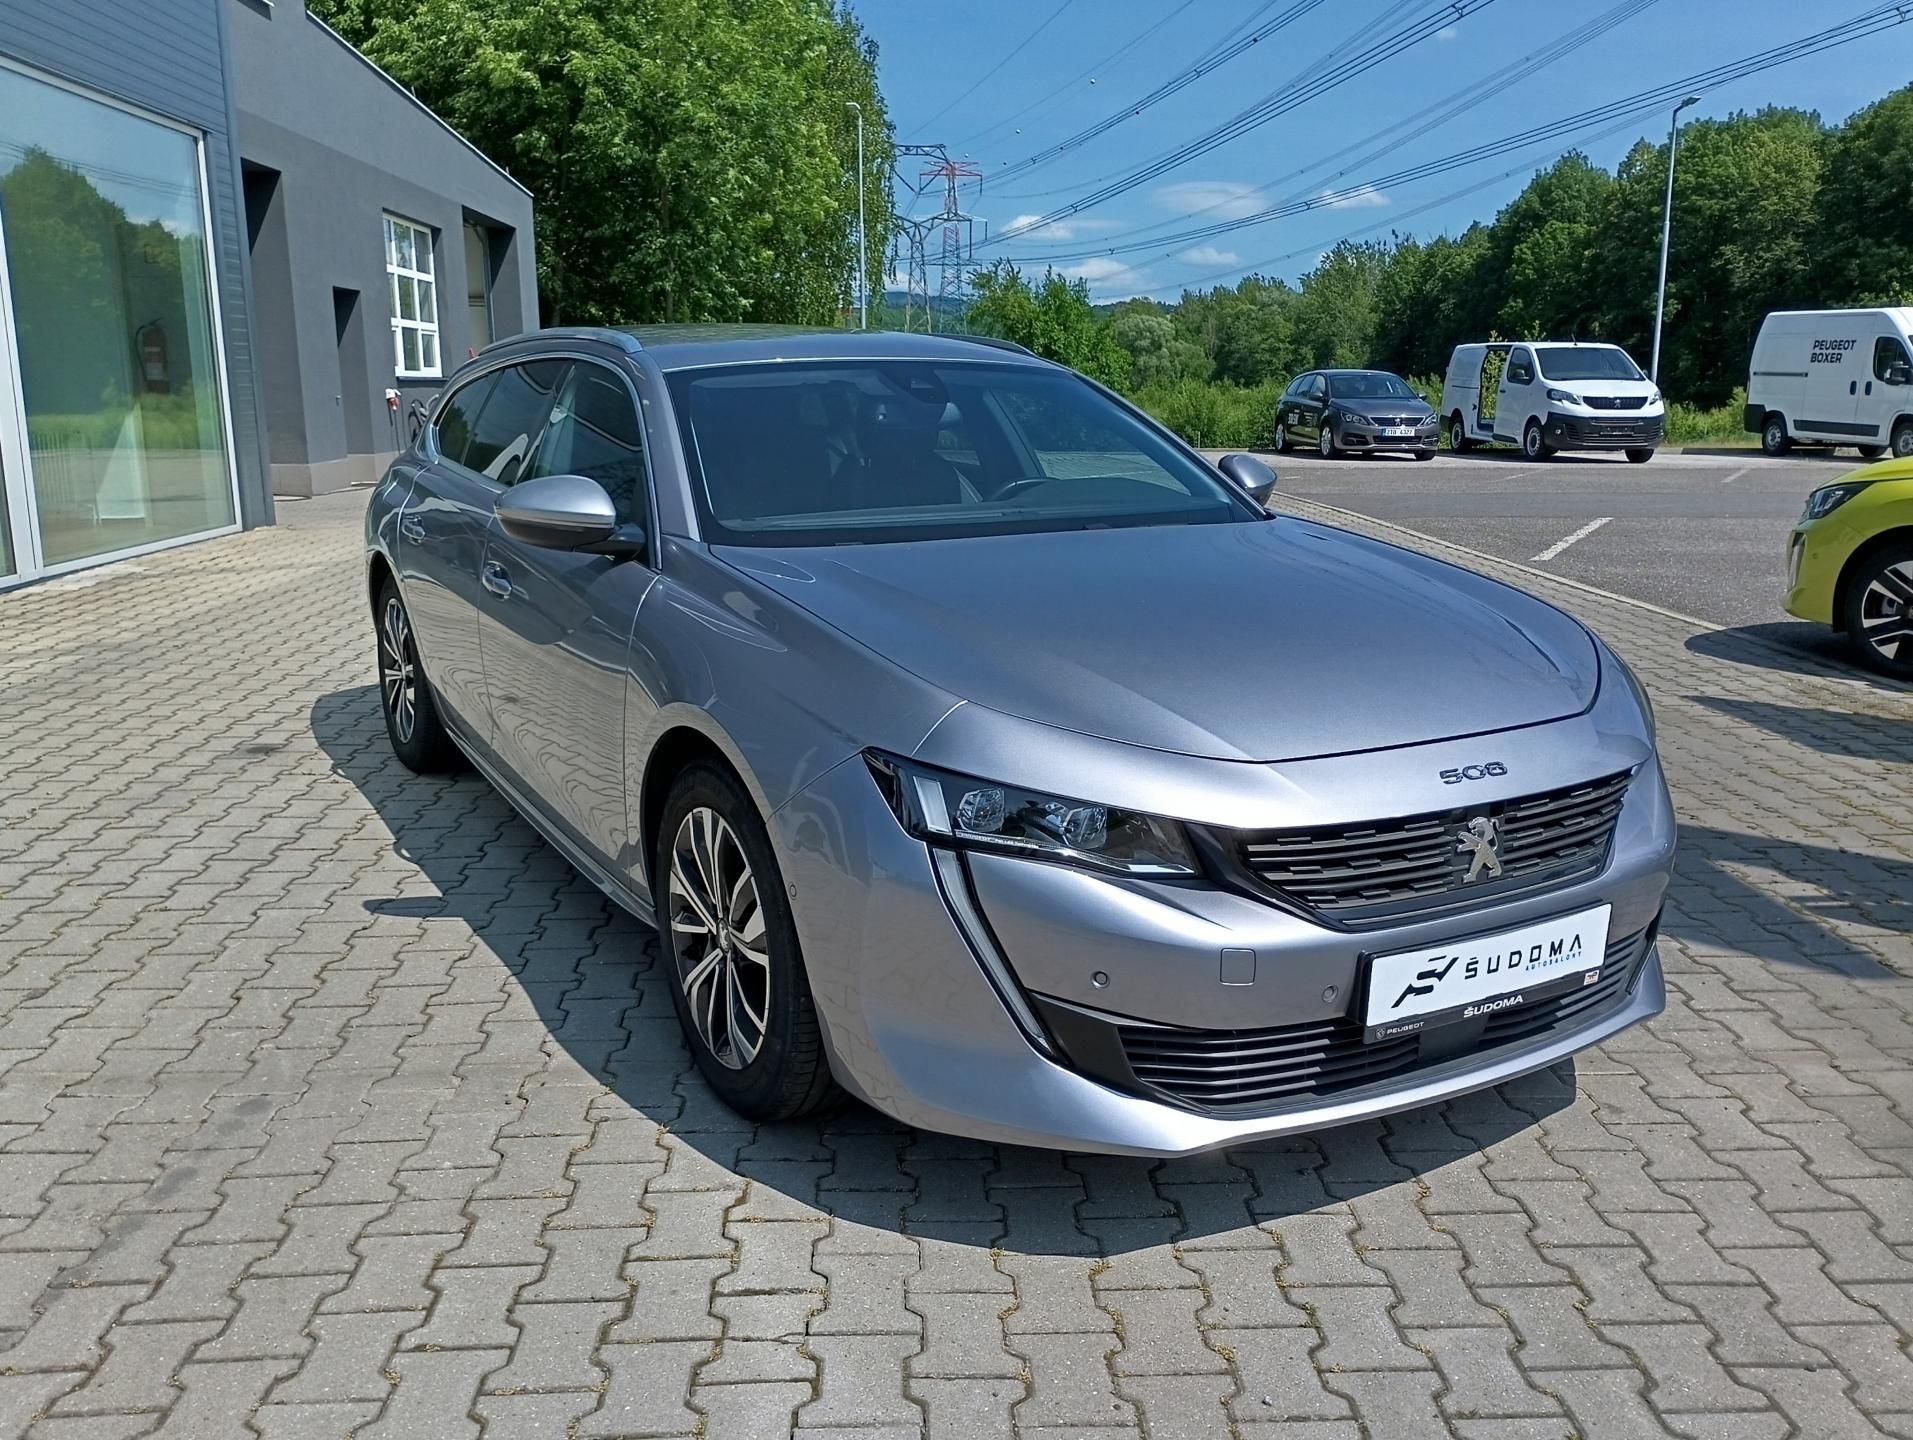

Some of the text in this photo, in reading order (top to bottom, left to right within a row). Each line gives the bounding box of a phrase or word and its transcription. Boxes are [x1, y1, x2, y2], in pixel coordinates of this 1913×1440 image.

[1813, 339, 1857, 351] PEUGEOT
[1810, 352, 1843, 364] BOXER
[1439, 761, 1508, 784] 508
[1464, 933, 1582, 980] ŠUDOMA
[1463, 994, 1524, 1018] ŠUDOMA
[1387, 1021, 1425, 1035] PEUGEOT
